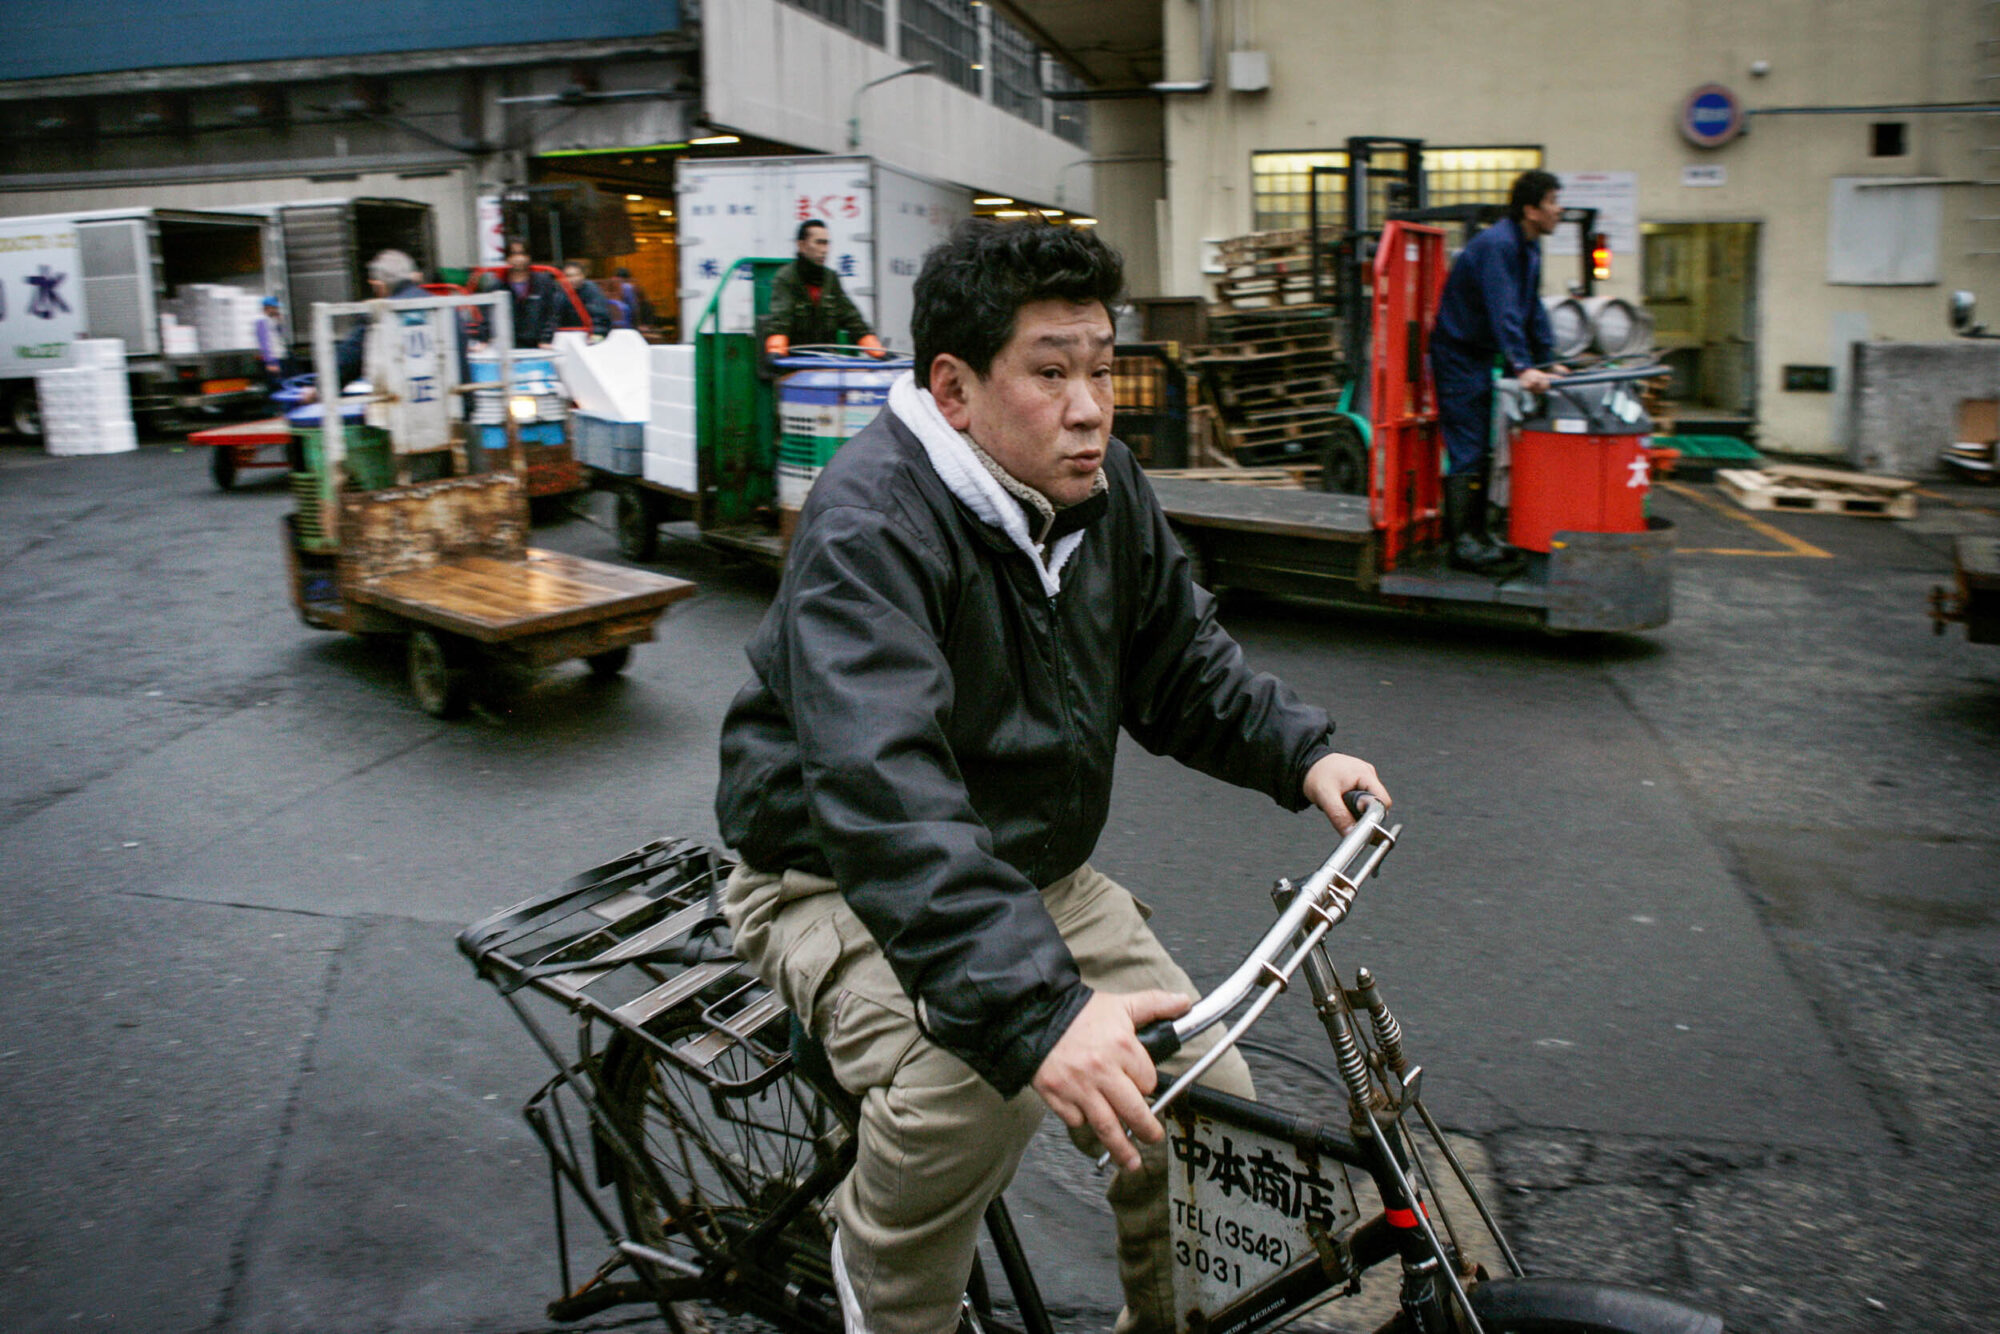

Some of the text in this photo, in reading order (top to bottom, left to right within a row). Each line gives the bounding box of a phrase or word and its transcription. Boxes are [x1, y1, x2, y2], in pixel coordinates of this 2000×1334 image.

[795, 195, 861, 221] まぐろ
[1171, 1124, 1336, 1232] 中本商店
[1176, 1240, 1242, 1289] 3031
